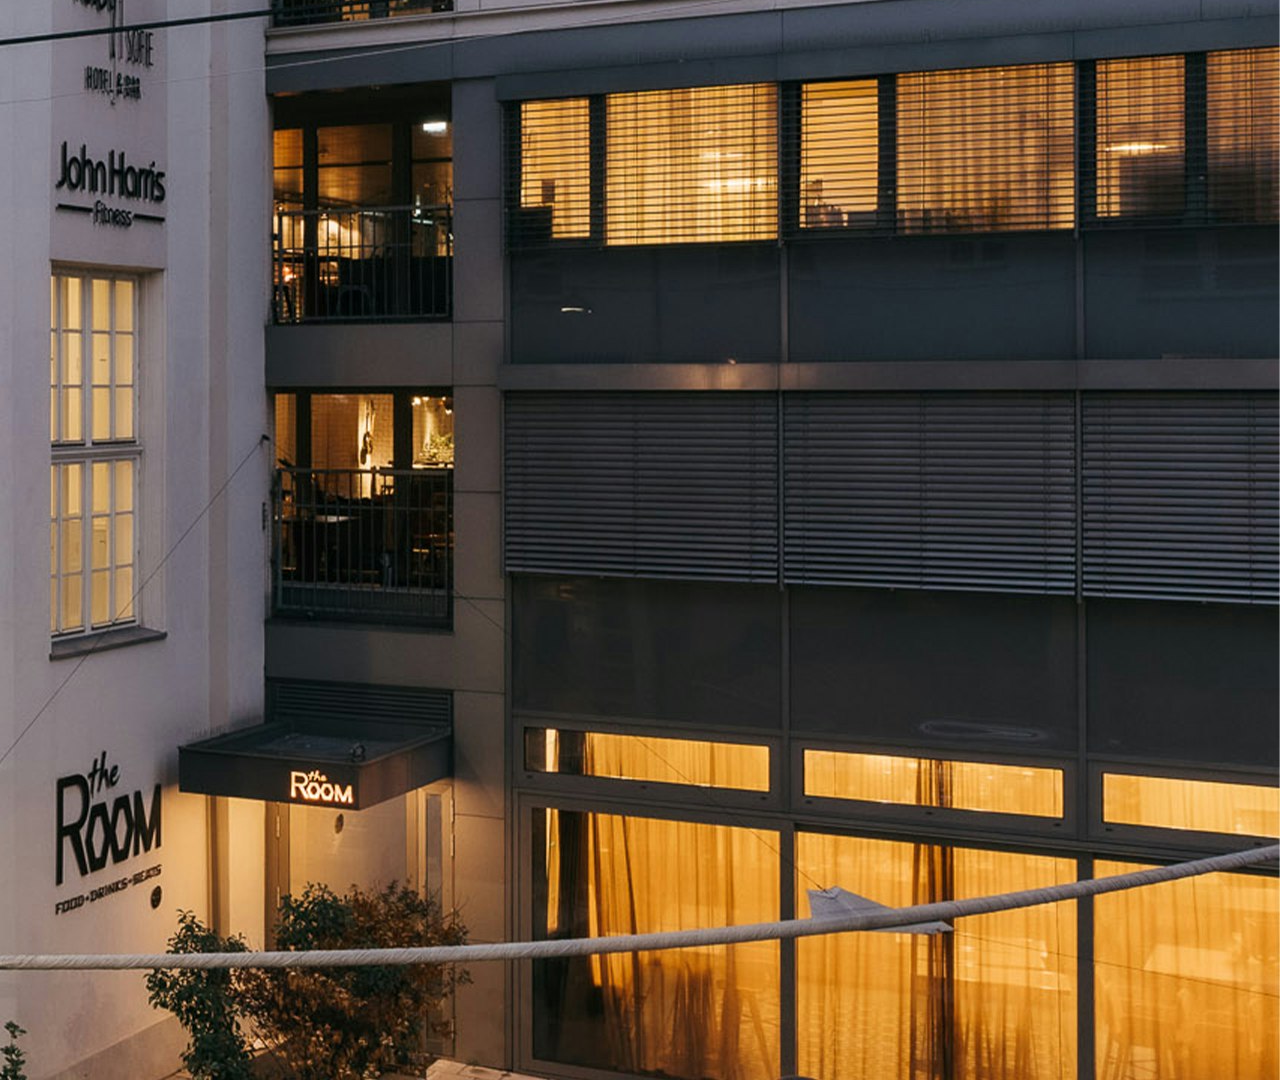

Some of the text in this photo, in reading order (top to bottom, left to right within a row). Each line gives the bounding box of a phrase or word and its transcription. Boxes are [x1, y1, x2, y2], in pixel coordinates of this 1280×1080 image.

[85, 66, 114, 93] HOTEL
[55, 141, 165, 203] John Harris
[87, 750, 120, 799] the
[290, 771, 353, 804] ROOM
[308, 770, 328, 782] the
[55, 773, 162, 887] ROOM
